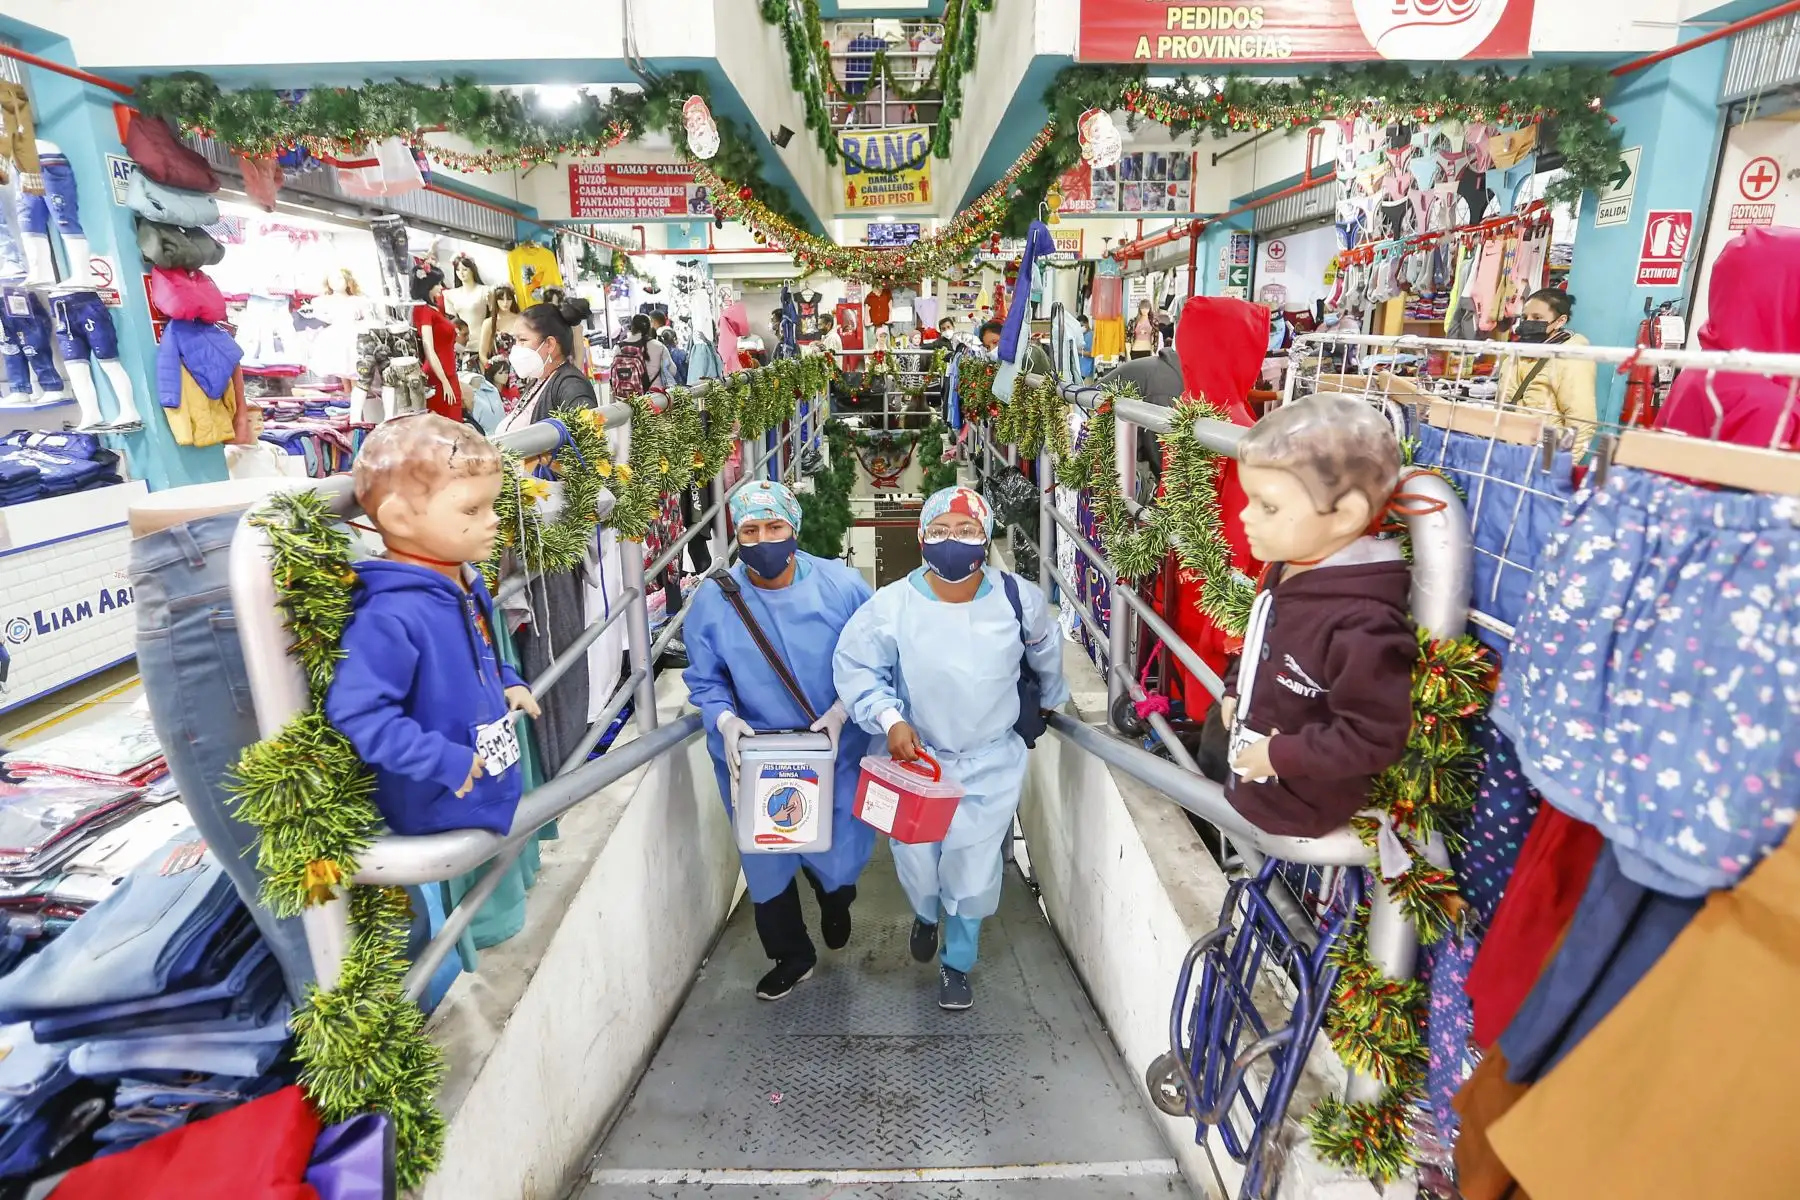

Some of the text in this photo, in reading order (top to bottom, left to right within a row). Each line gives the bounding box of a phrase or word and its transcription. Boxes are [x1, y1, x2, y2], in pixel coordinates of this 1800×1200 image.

[1166, 6, 1264, 30] PEDIDOS
[1134, 35, 1292, 59] A PROVINCIAS
[843, 132, 927, 176] BAÑO
[578, 164, 694, 174] POLOS DAMAS CABALL
[579, 175, 607, 185] BUZOS
[868, 176, 898, 184] DAMAS
[580, 186, 684, 196] CASACAS IMPERMEABLES
[861, 183, 914, 194] CABALLEROS
[580, 197, 670, 207] PANTALONES JOGGER
[862, 192, 915, 206] 2DO PISO
[580, 208, 664, 217] PANTALONES JEANS
[1599, 205, 1627, 219] SALIDA
[1732, 205, 1774, 218] BOTIQUIN
[1056, 240, 1078, 249] PISO
[1046, 252, 1075, 260] VICTORIA
[1639, 267, 1678, 278] EXTINTOR
[33, 600, 93, 636] LIAM
